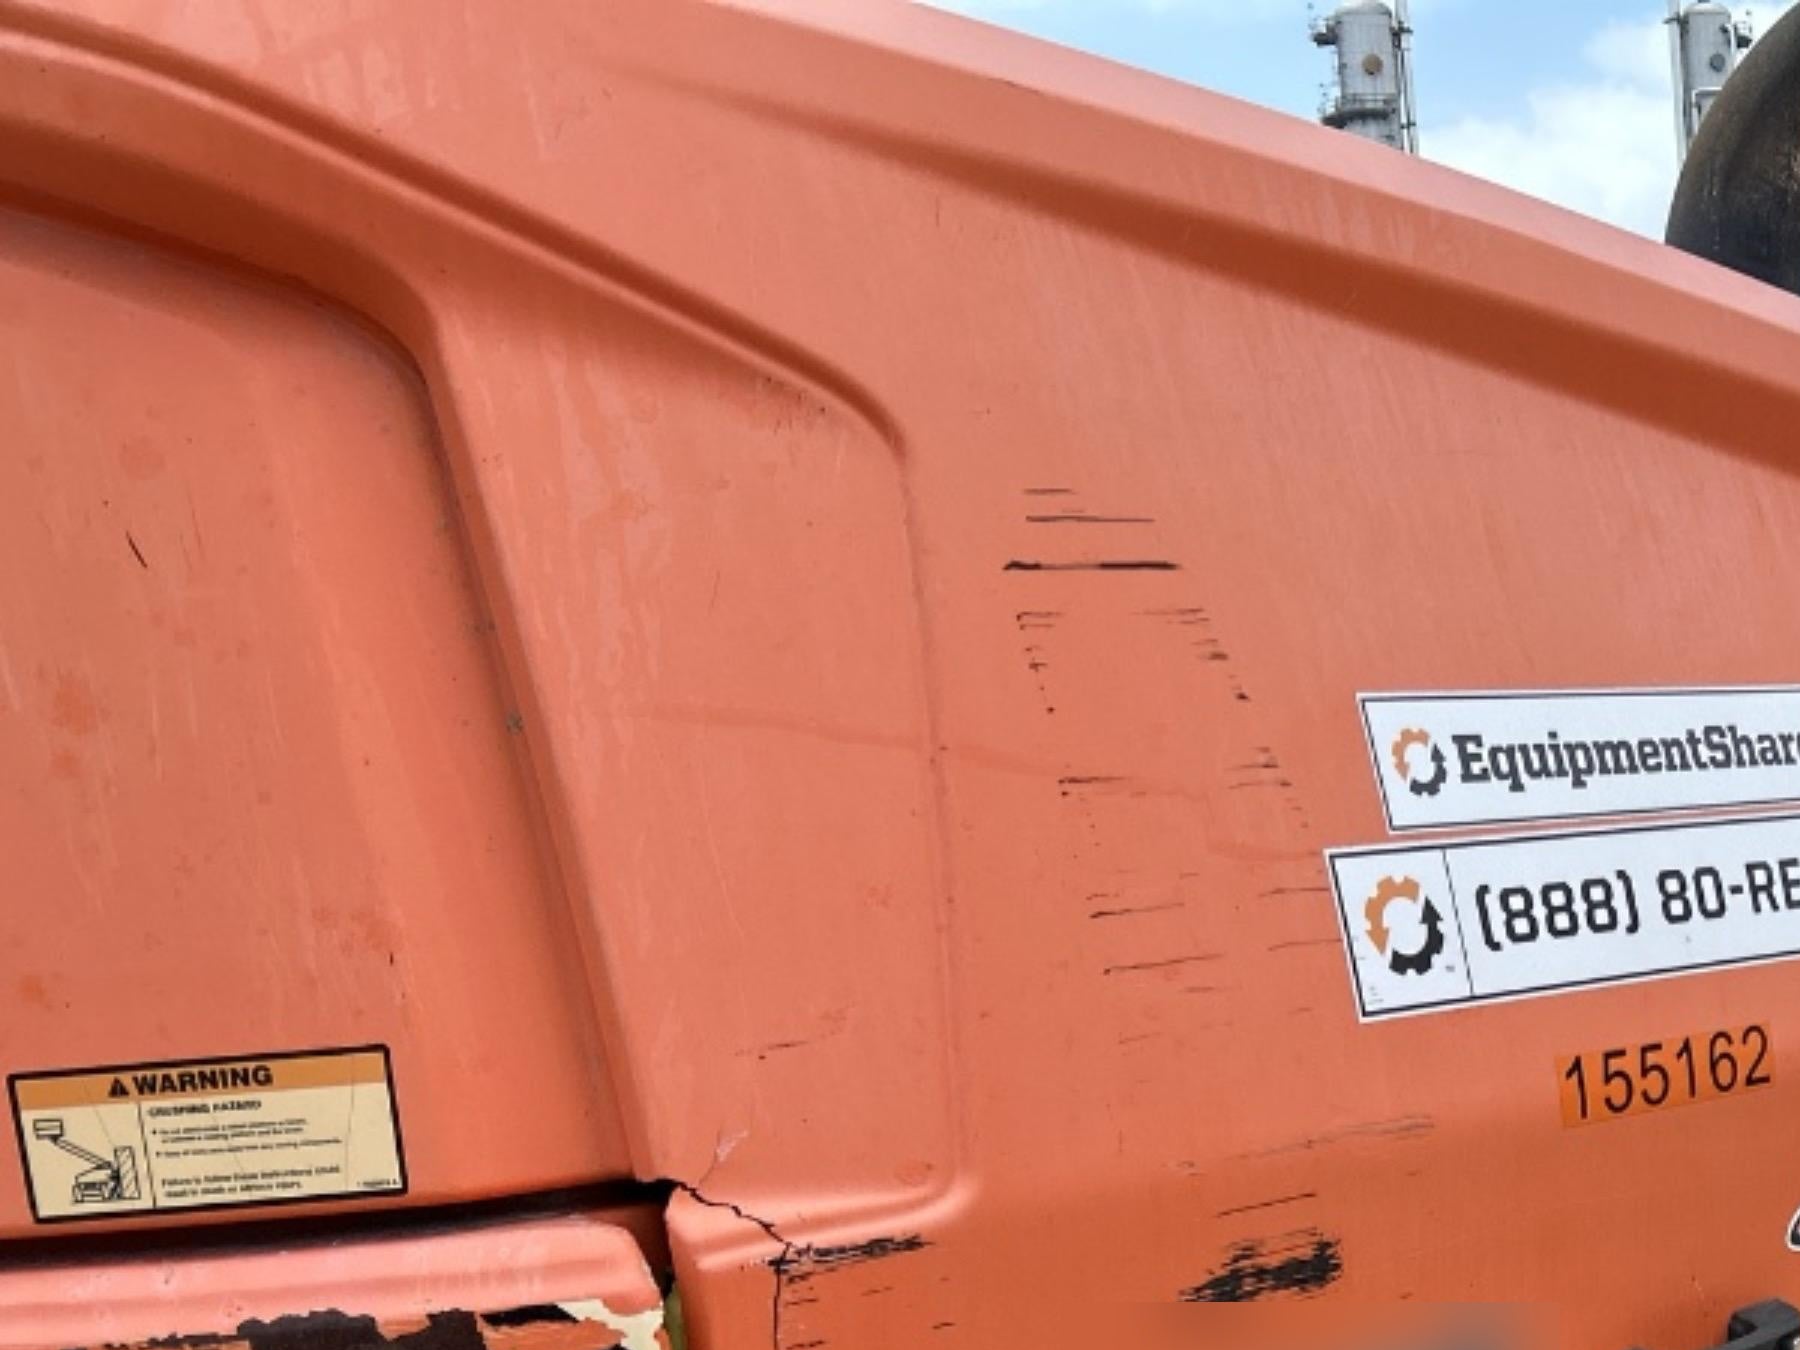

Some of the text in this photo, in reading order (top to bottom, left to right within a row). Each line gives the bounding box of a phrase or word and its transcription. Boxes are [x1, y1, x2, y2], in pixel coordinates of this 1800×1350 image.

[1475, 869, 1640, 952] (888)
[133, 1064, 273, 1096] WARNING
[1564, 1024, 1772, 1121] 155162
